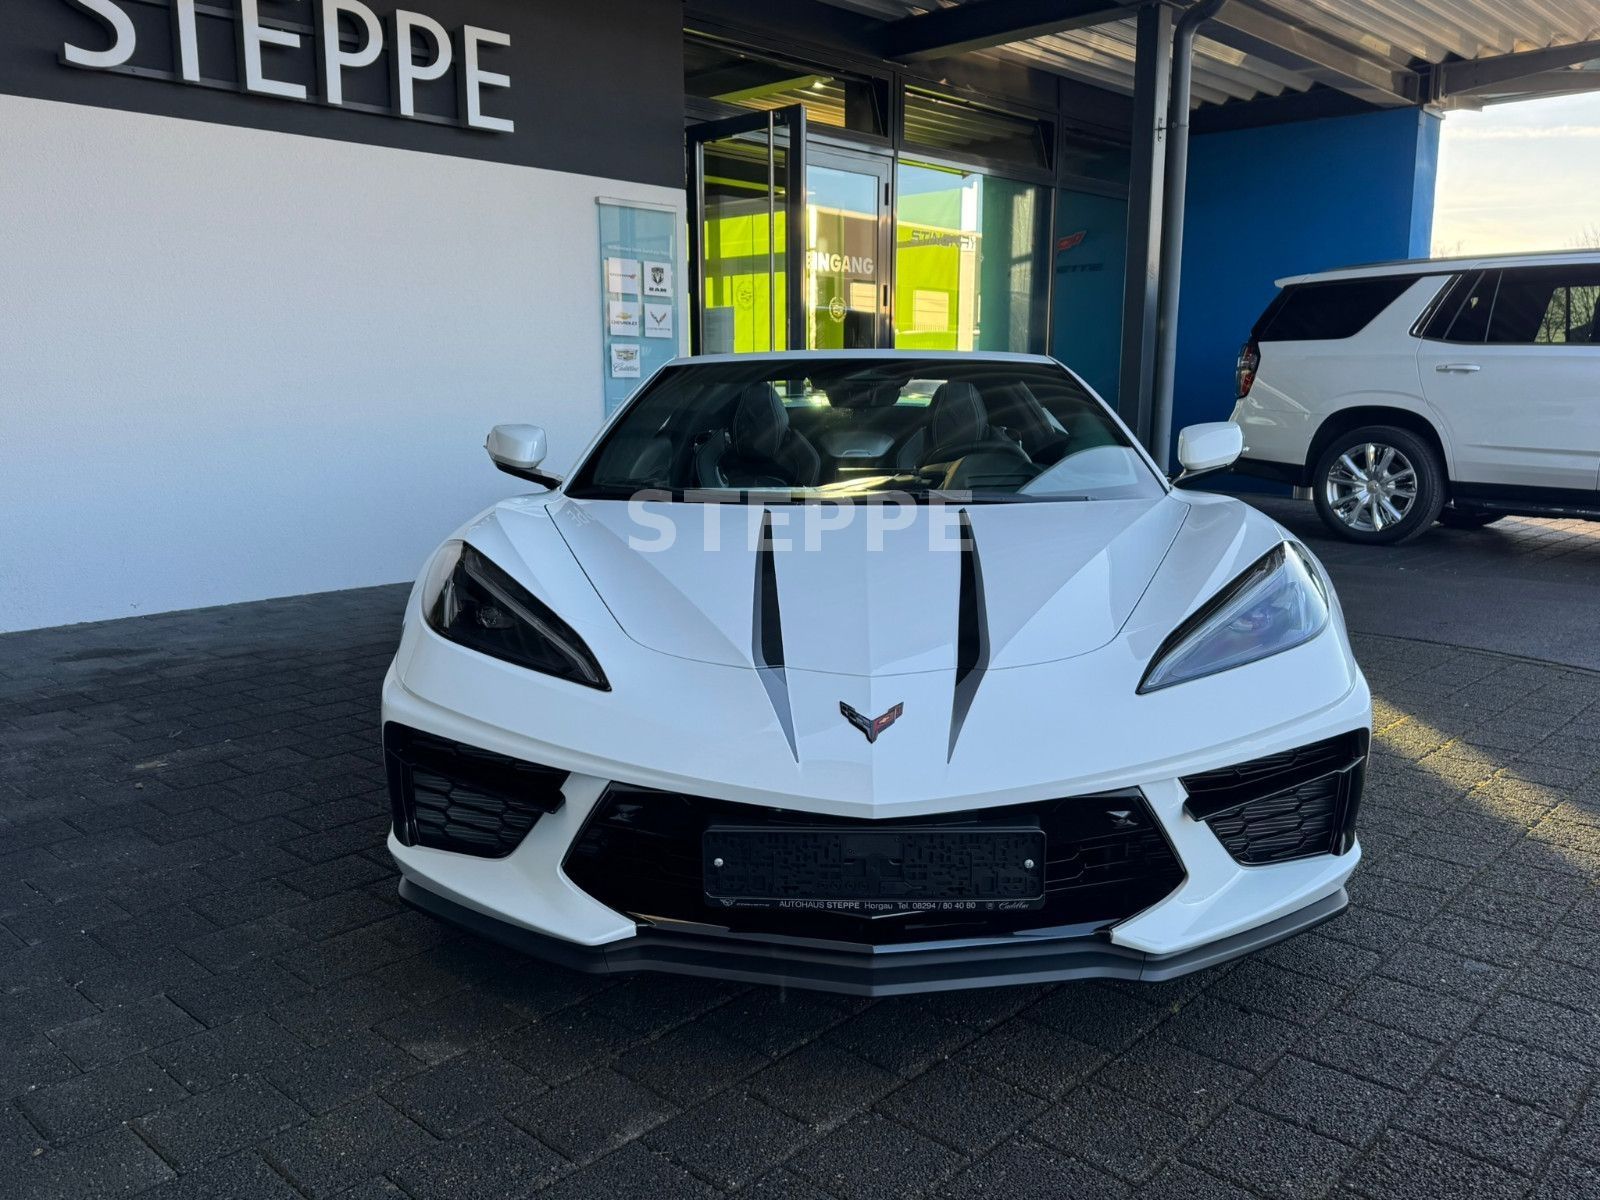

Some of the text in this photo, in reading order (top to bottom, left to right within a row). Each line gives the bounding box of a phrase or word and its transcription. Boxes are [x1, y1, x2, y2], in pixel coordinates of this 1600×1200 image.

[779, 901, 825, 909] AUTOHAUS
[826, 901, 860, 909] STEPPE
[864, 901, 893, 911] Horgau
[912, 902, 936, 910] 08294
